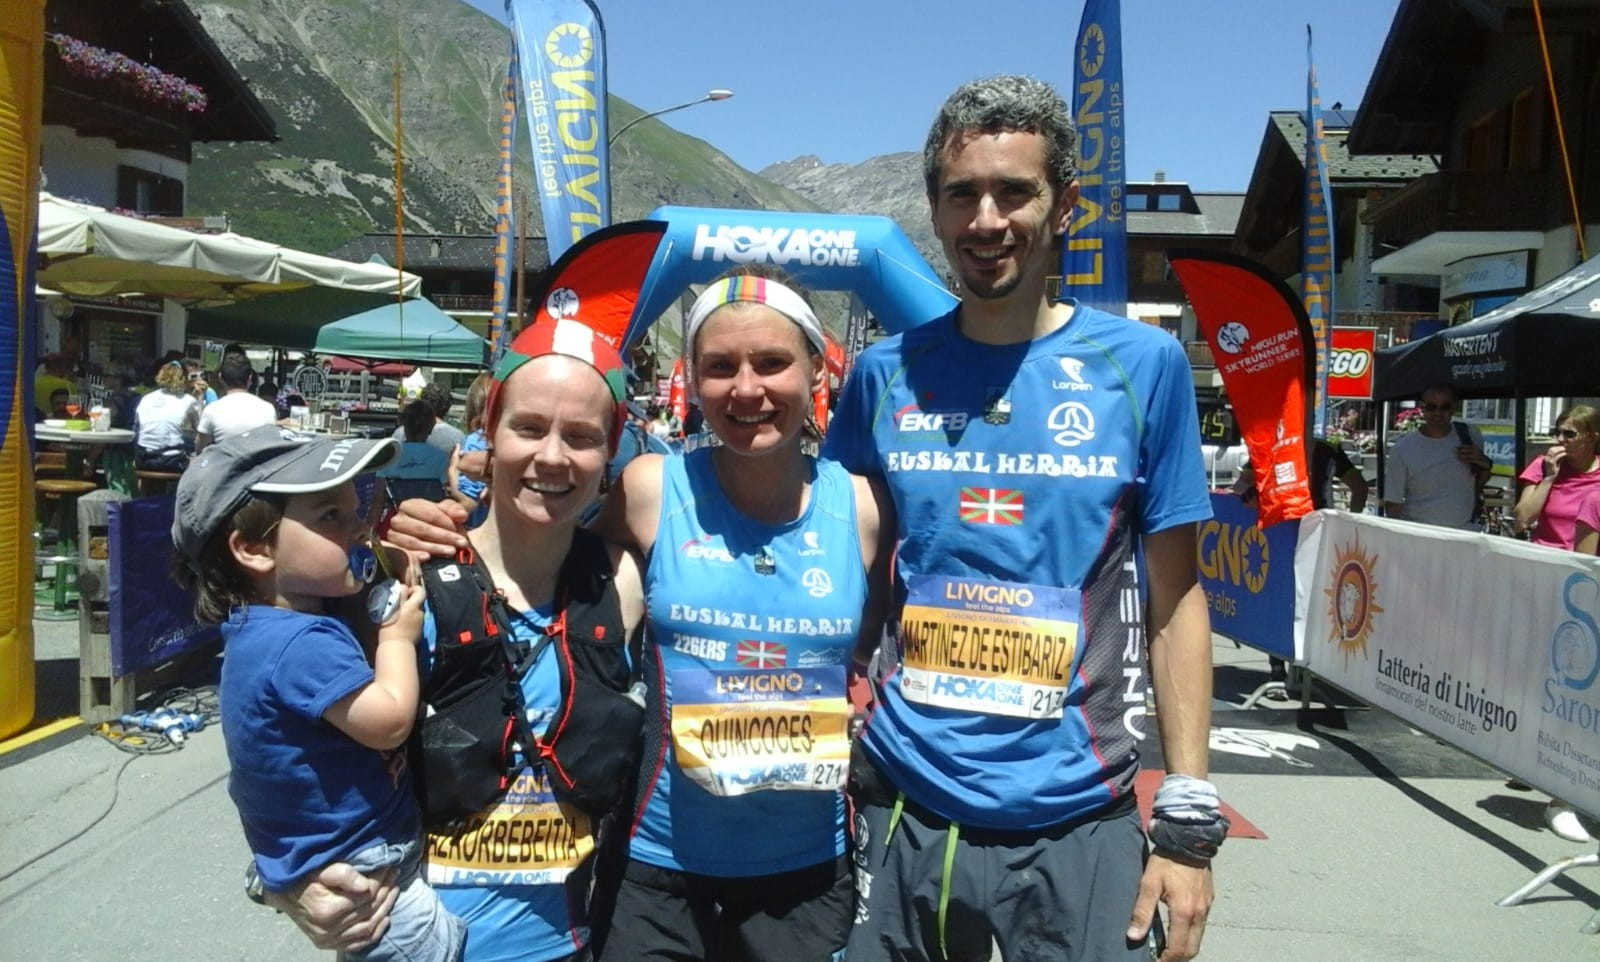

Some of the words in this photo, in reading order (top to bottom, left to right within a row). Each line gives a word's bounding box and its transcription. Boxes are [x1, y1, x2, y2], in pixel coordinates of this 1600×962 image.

[1107, 81, 1121, 131] alps
[1108, 135, 1122, 178] the
[1107, 184, 1122, 223] feel
[692, 223, 811, 265] HOKA
[809, 228, 857, 249] ONE
[810, 247, 861, 267] ONE
[1277, 327, 1299, 342] RUN
[1224, 343, 1288, 373] SKYRUNNER
[1244, 358, 1274, 375] WORLD
[1328, 350, 1368, 376] EGO
[1052, 380, 1093, 392] Lorpen
[899, 412, 969, 432] EKFB
[945, 582, 1034, 608] LIVIGNO
[1215, 590, 1236, 618] alps
[673, 632, 728, 662] 226ERS
[904, 620, 969, 668] MARTINEZ
[969, 626, 990, 671] DE
[991, 629, 1067, 681] ESTIBARIZ
[1119, 551, 1147, 742] TERNU
[716, 673, 803, 694] LIVIGNO
[932, 675, 996, 700] HOKA
[996, 682, 1024, 695] ONE
[1377, 649, 1430, 695] Latteria
[1435, 671, 1451, 703] di
[1455, 680, 1517, 733] Livigno
[996, 694, 1025, 706] ONE
[1428, 704, 1455, 726] nostro
[1456, 712, 1477, 736] latte
[701, 714, 812, 759] QUINCOCES
[509, 774, 552, 794] GNO
[815, 763, 843, 786] 271
